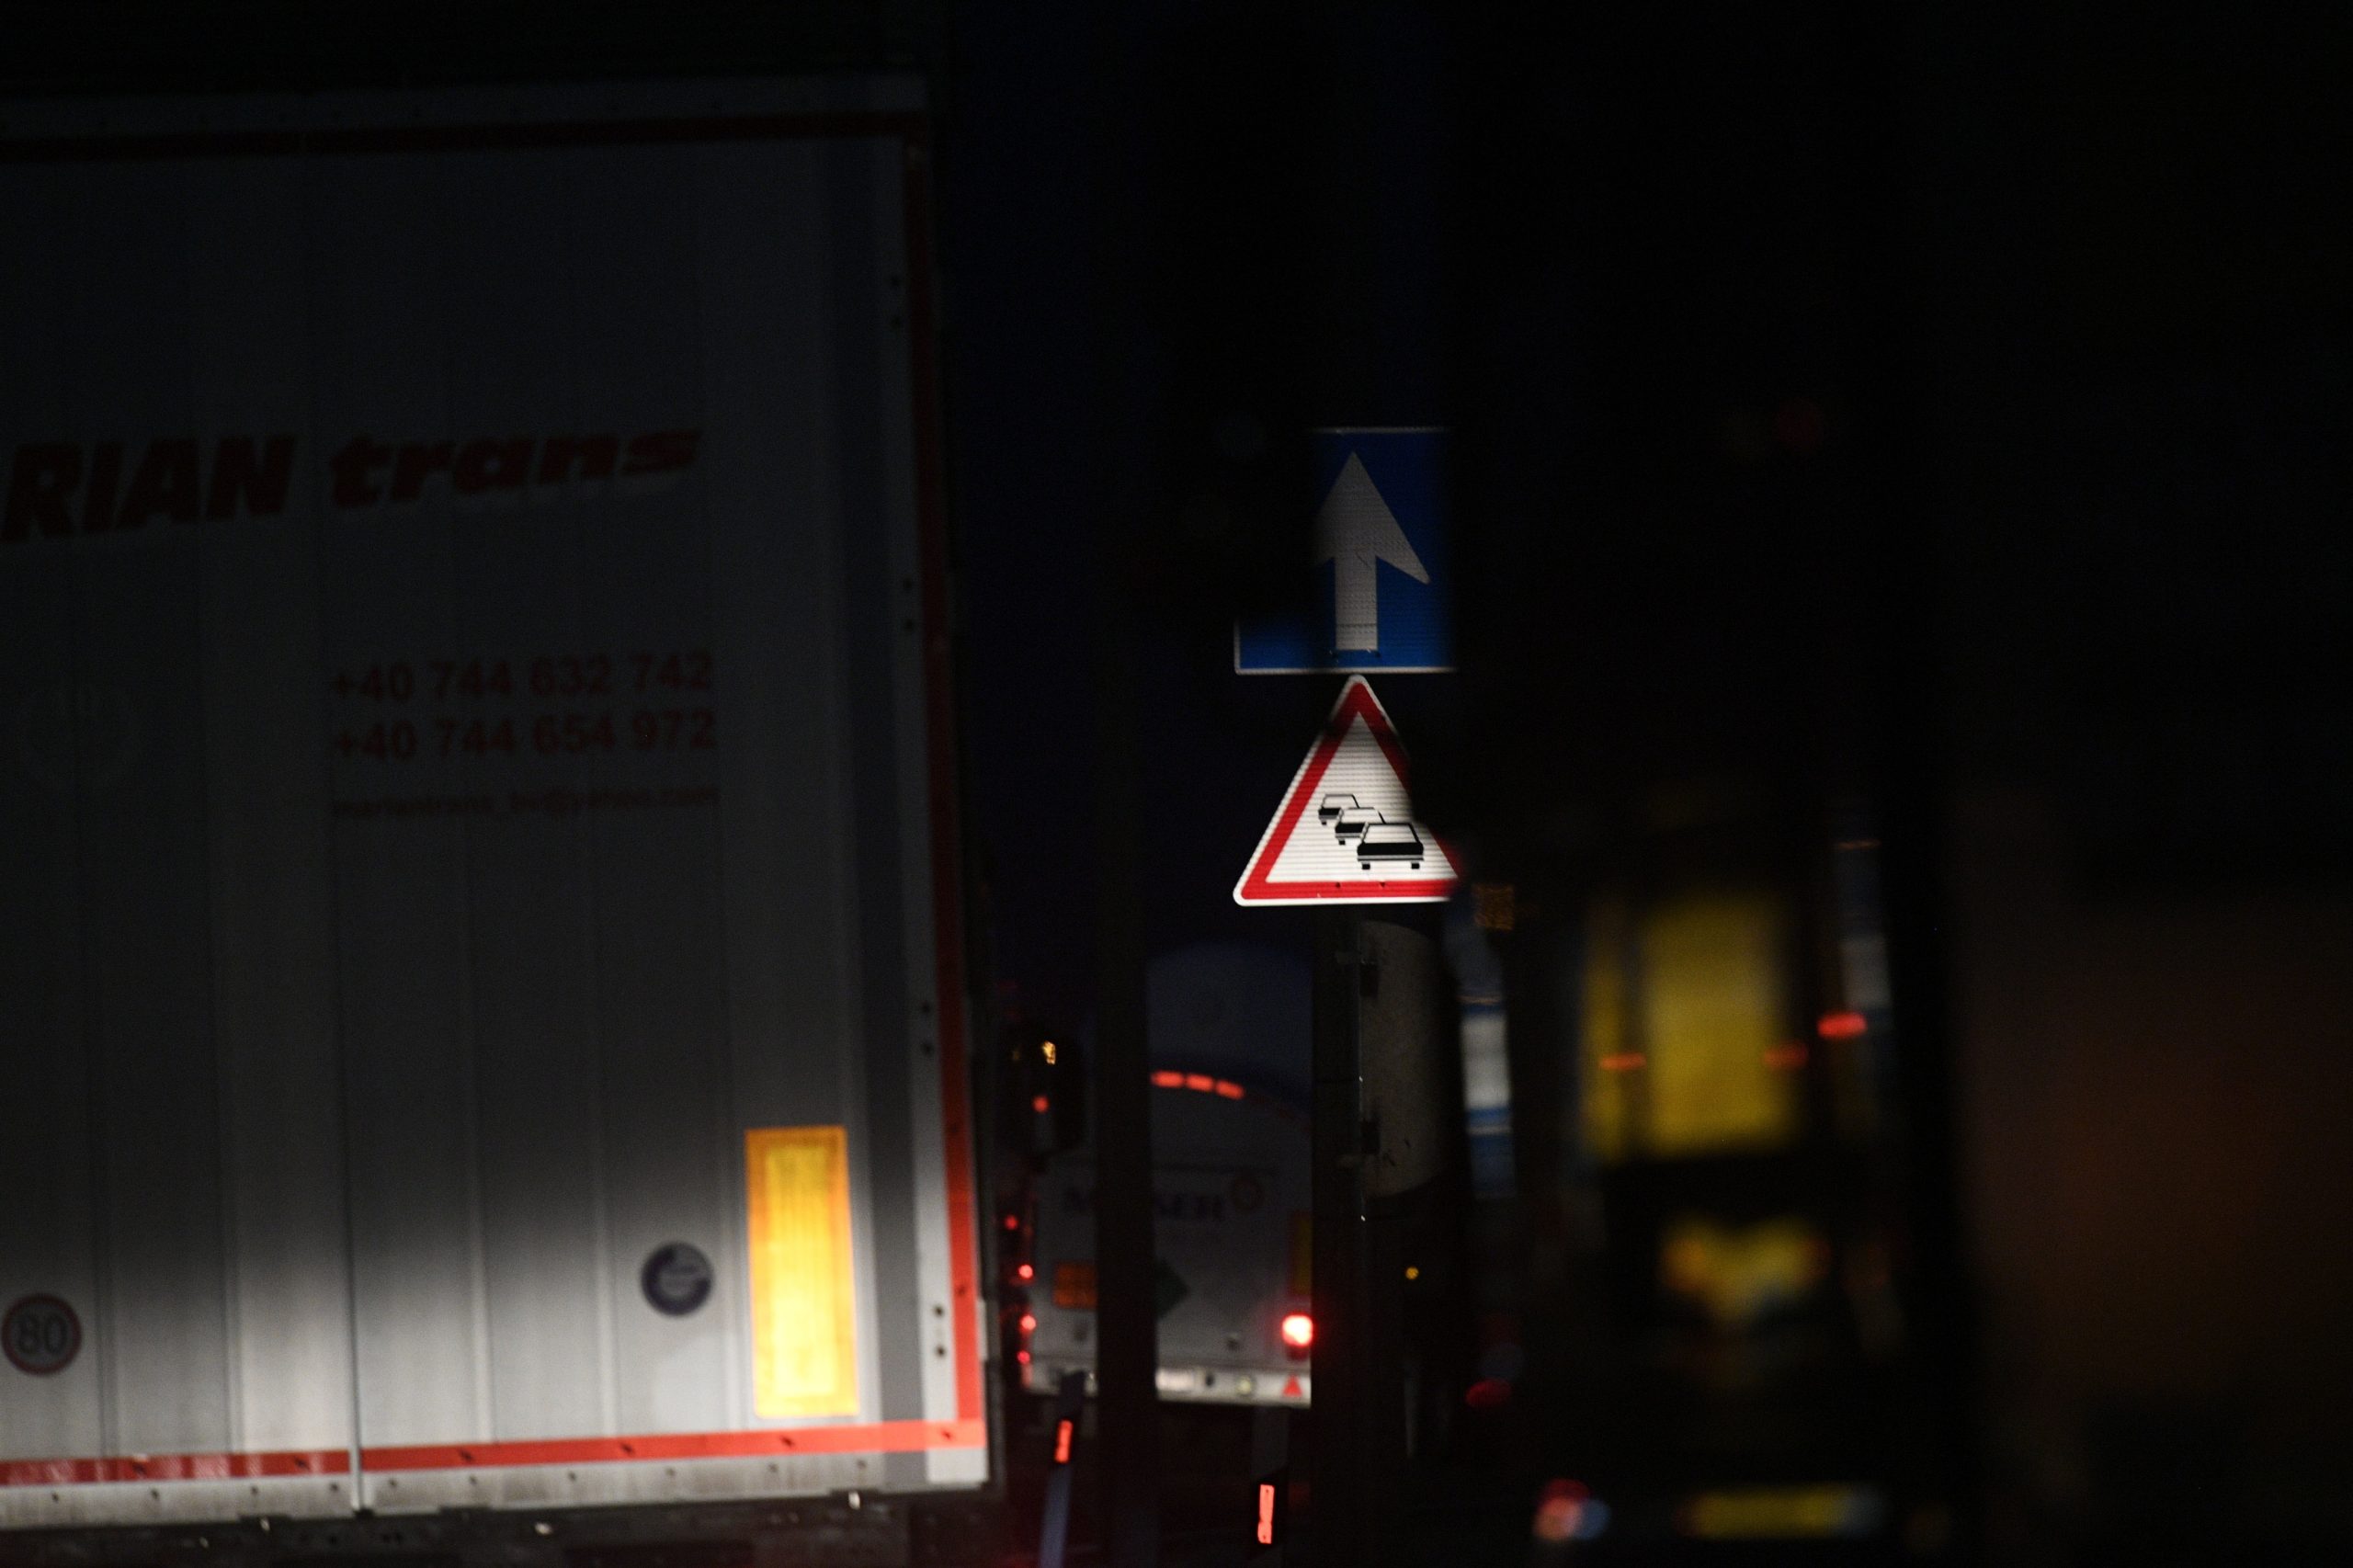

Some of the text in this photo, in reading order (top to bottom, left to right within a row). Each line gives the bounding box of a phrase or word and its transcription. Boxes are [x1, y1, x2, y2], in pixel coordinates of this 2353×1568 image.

[2, 428, 705, 543] RIAN trans
[330, 648, 714, 703] +40 744 632 742
[334, 707, 719, 762] +40 744 654 972
[18, 1313, 68, 1355] 80
